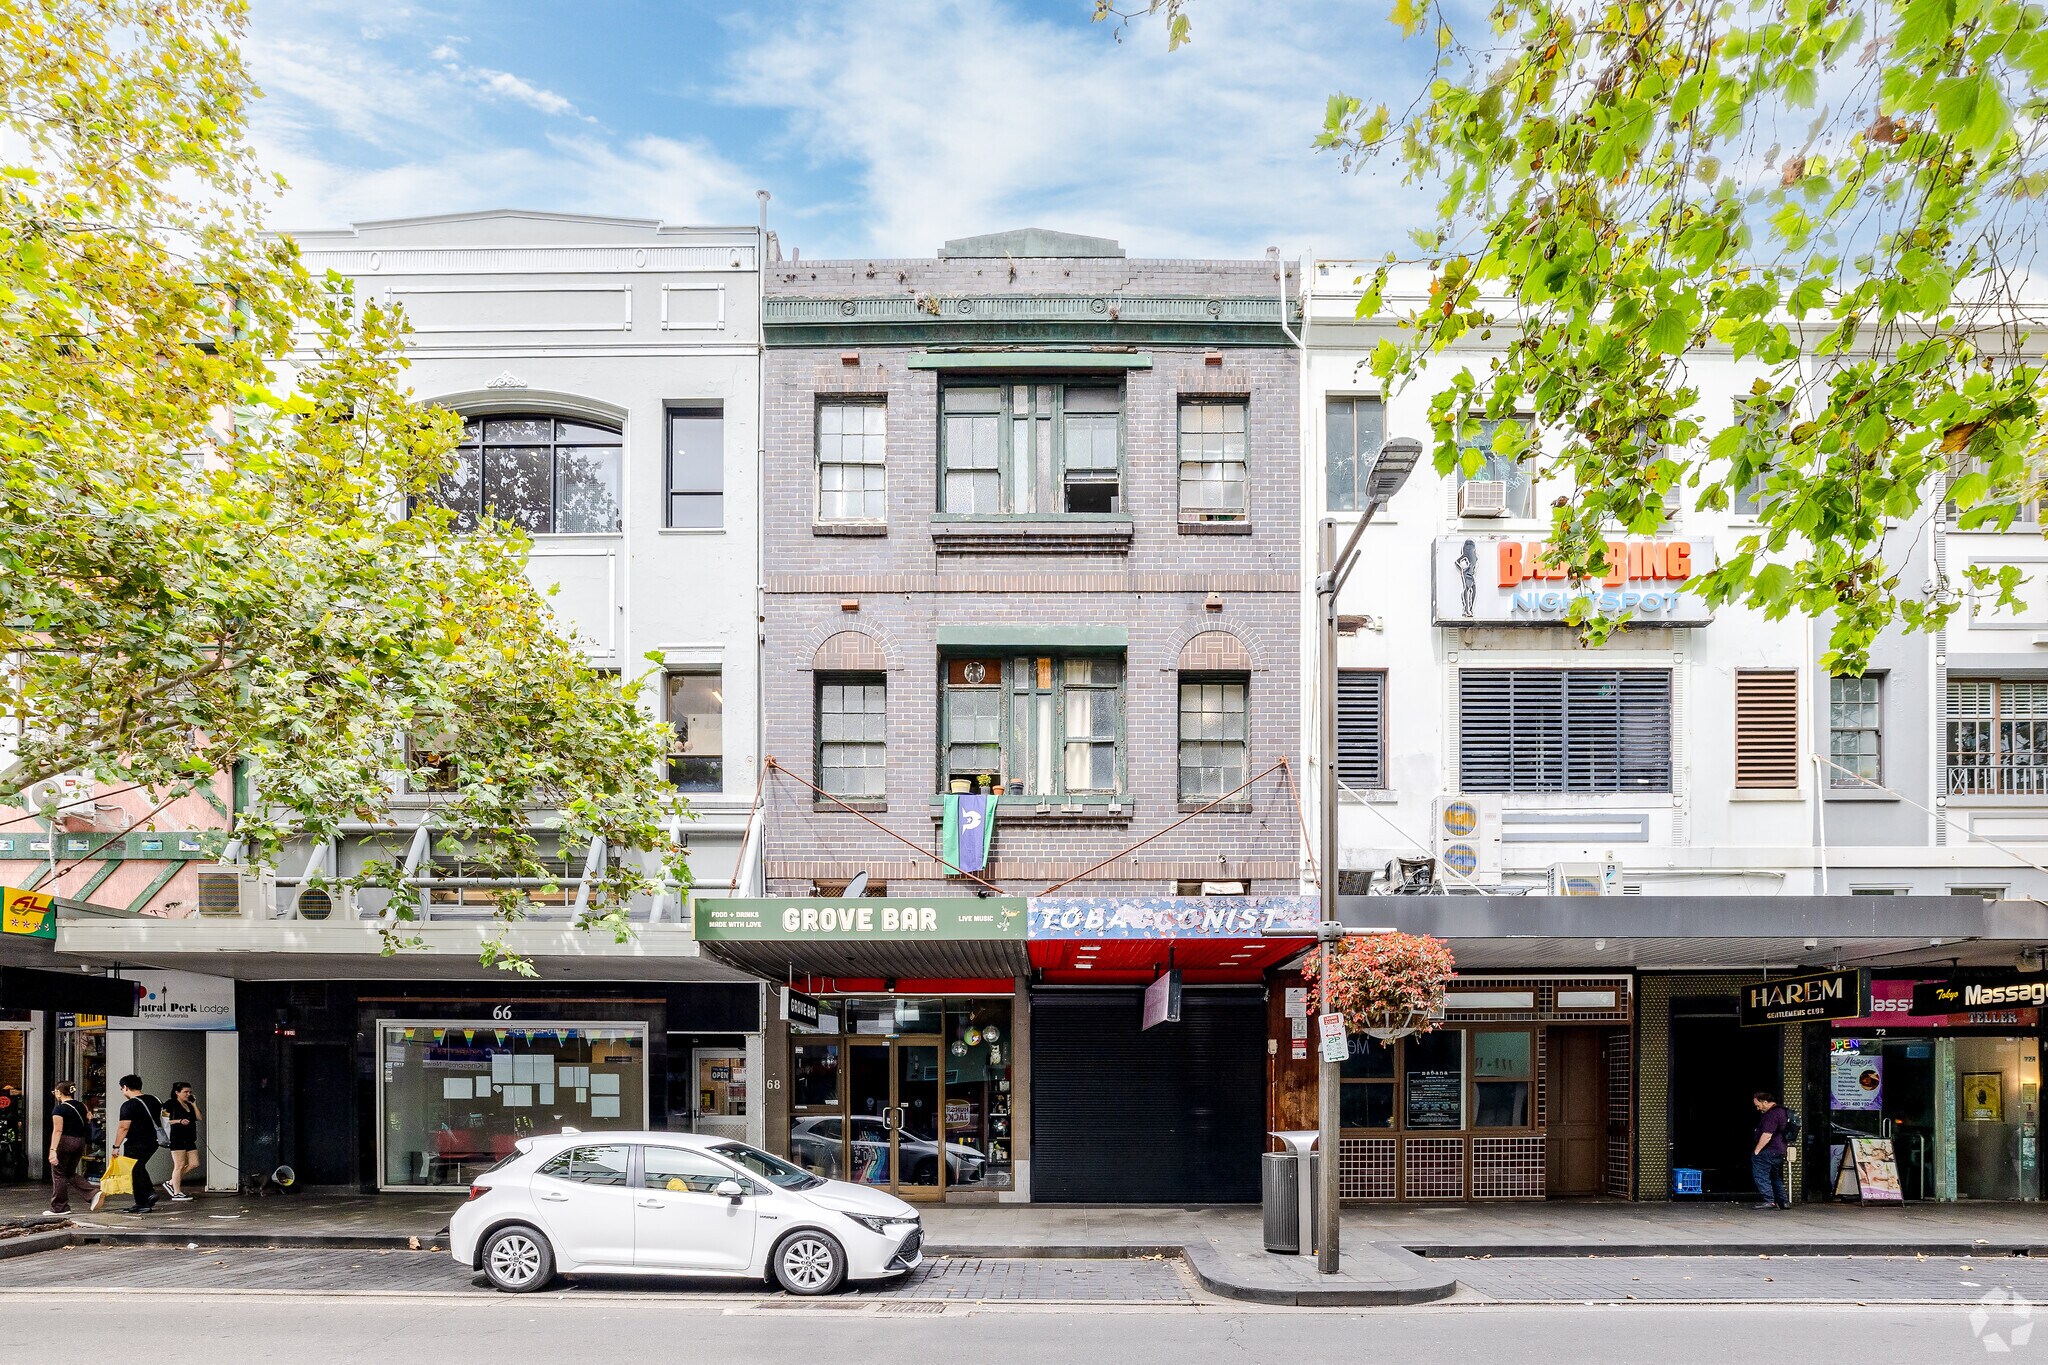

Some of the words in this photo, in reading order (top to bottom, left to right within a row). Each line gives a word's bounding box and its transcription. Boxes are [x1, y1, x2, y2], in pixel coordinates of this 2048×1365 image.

[1602, 541, 1692, 587] BING
[782, 907, 873, 932] GROVE
[881, 907, 938, 932] BAR
[1751, 977, 1843, 1008] HAREM
[1935, 988, 1959, 1002] Tokyo
[171, 1003, 197, 1012] Perk
[200, 1004, 230, 1015] Lodge
[492, 1005, 513, 1020] 66
[790, 998, 807, 1017] GROVE
[807, 1004, 817, 1019] BAR
[1808, 1008, 1825, 1016] CLUB
[1968, 1012, 2018, 1024] TELLER
[1328, 1036, 1341, 1044] 2P
[711, 1071, 729, 1079] OPEN
[766, 1079, 781, 1090] 68
